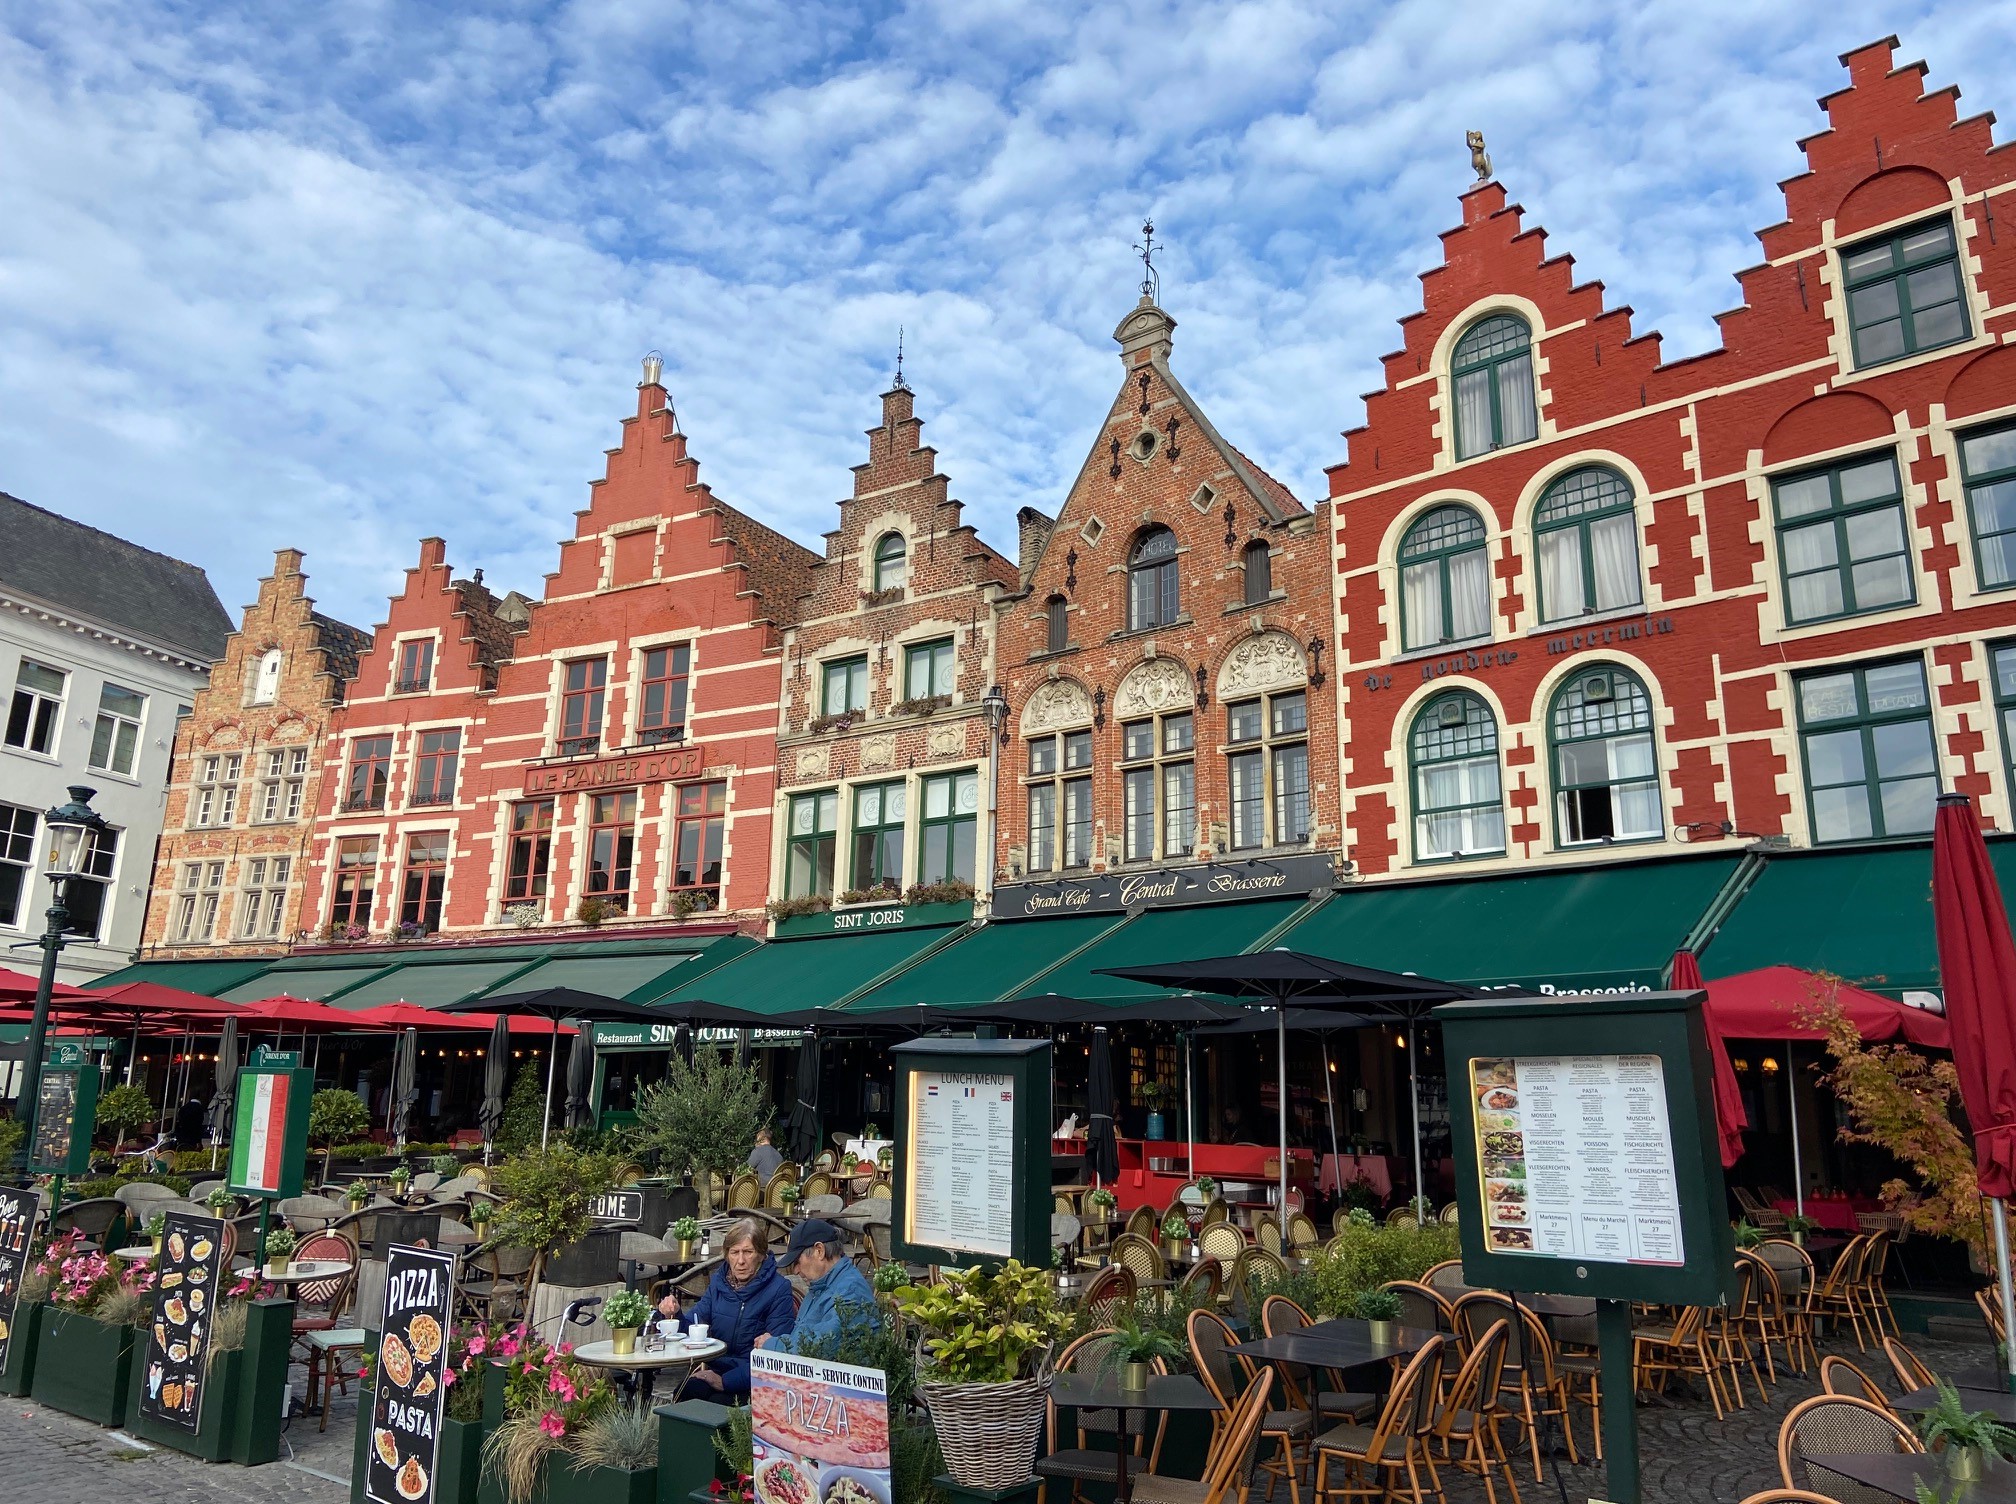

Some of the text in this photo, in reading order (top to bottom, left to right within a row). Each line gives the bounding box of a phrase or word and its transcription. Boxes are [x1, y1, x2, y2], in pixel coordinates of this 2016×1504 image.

[1143, 540, 1173, 557] HOTEL
[1547, 613, 1673, 655] meermin
[532, 753, 698, 792] LE PANIER D'OR
[1024, 891, 1064, 915] Grand
[1119, 876, 1178, 906] Central
[1207, 871, 1287, 894] Brasserie
[834, 910, 904, 929] SINT JORIS
[596, 1032, 643, 1044] Restaurant
[941, 1073, 1005, 1086] LUNCH MENU
[1606, 1216, 1626, 1224] Marché
[388, 1268, 438, 1317] PIZZA
[752, 1354, 885, 1392] NON STOP KITCHEN SERVICE CONTINU
[387, 1399, 433, 1440] PASTA
[786, 1389, 850, 1437] PIZZA
